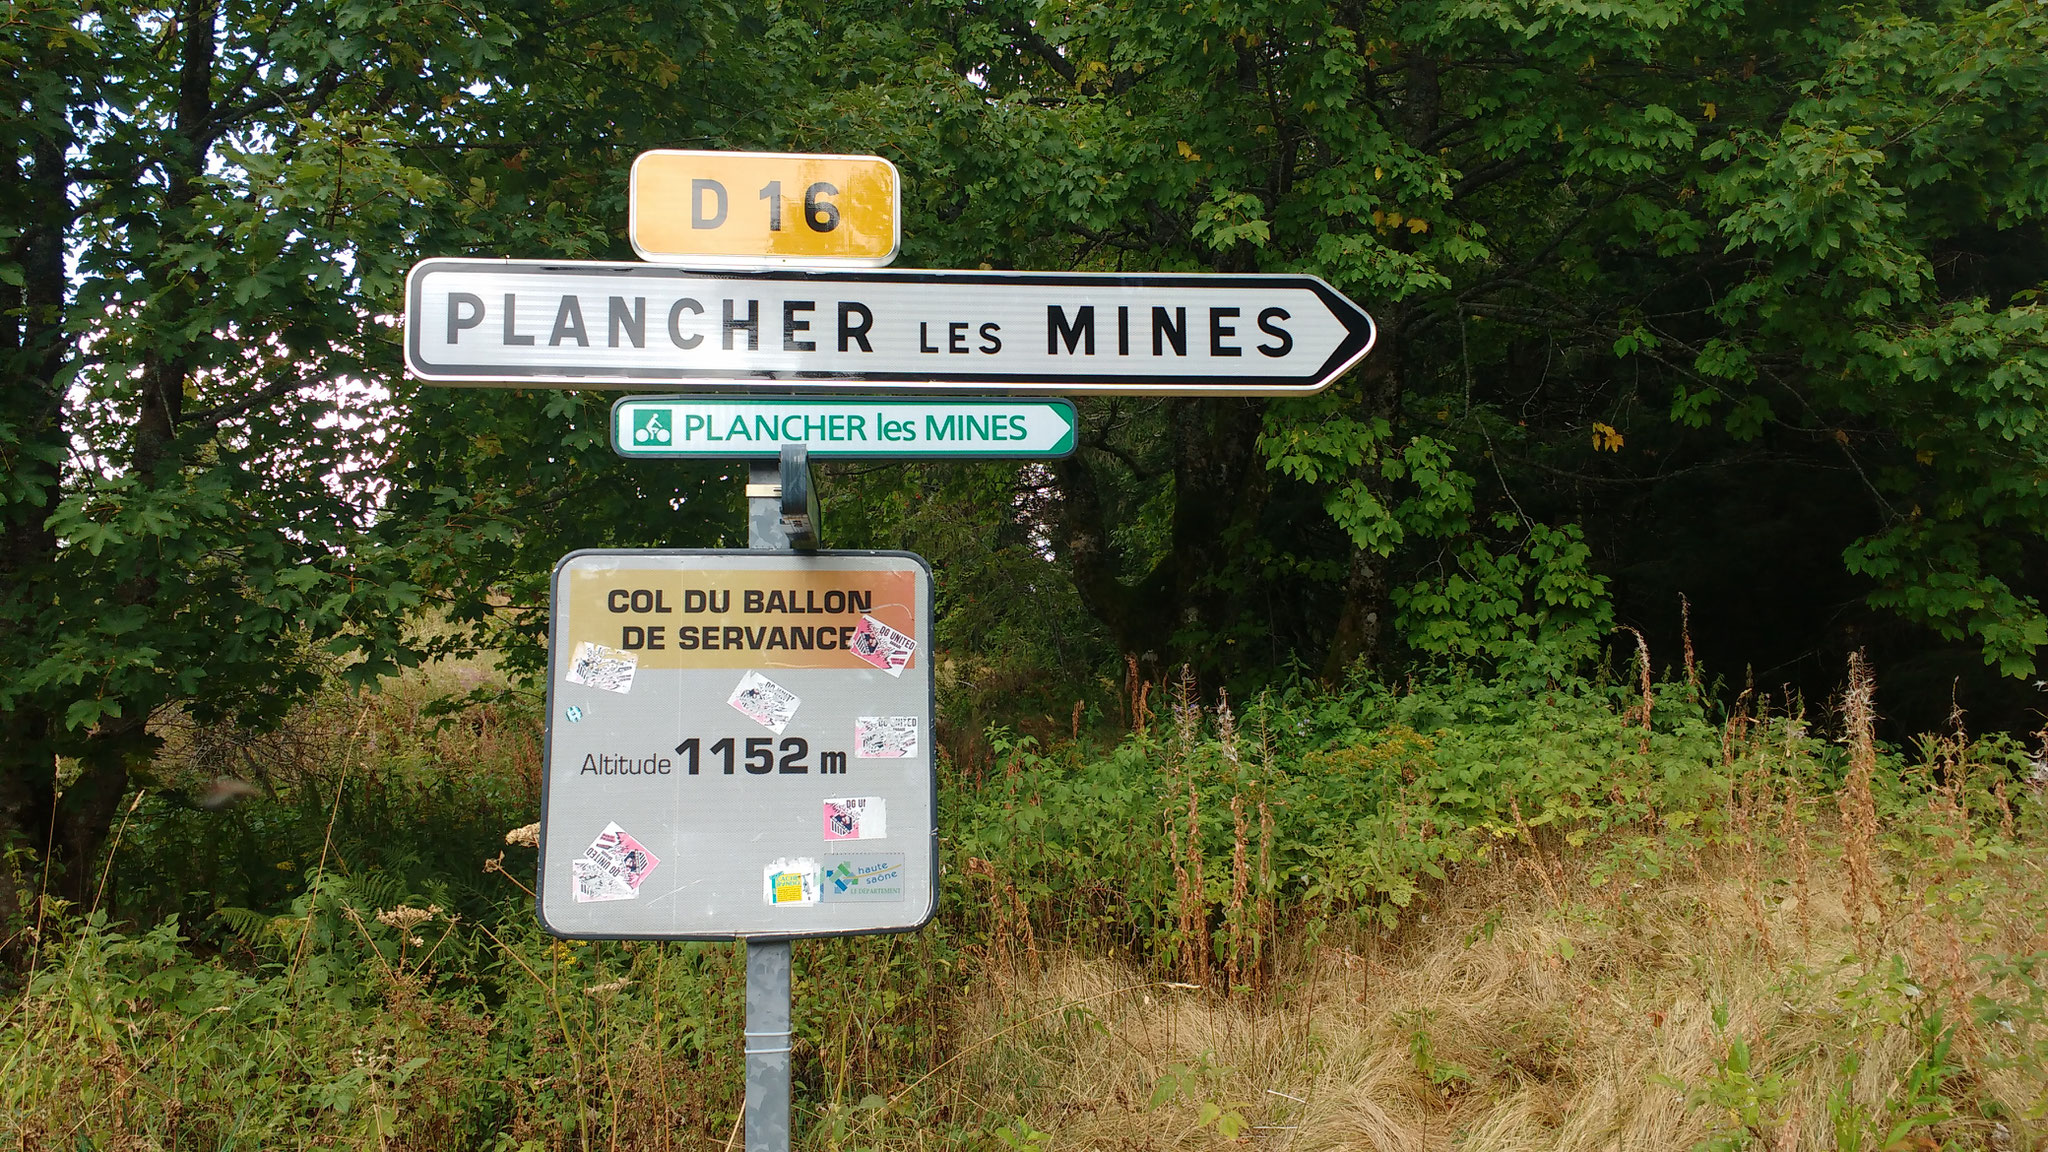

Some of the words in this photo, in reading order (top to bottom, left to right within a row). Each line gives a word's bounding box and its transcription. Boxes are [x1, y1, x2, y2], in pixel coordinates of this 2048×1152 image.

[691, 178, 729, 231] D
[759, 180, 840, 233] 16
[447, 293, 873, 352] PLANCHER
[921, 322, 1001, 354] LES
[1048, 305, 1293, 357] MINES
[686, 415, 868, 441] PLANCHER
[878, 413, 916, 441] les
[926, 415, 1027, 441] MINES
[609, 590, 671, 613] COL
[685, 590, 730, 613] DU
[744, 590, 871, 614] BALLON
[623, 627, 665, 650] DE
[679, 627, 855, 650] SERVANCE
[581, 753, 671, 775] Altitude
[675, 737, 808, 775] 1152
[821, 751, 846, 775] m
[858, 862, 889, 875] haute
[866, 871, 898, 885] saône
